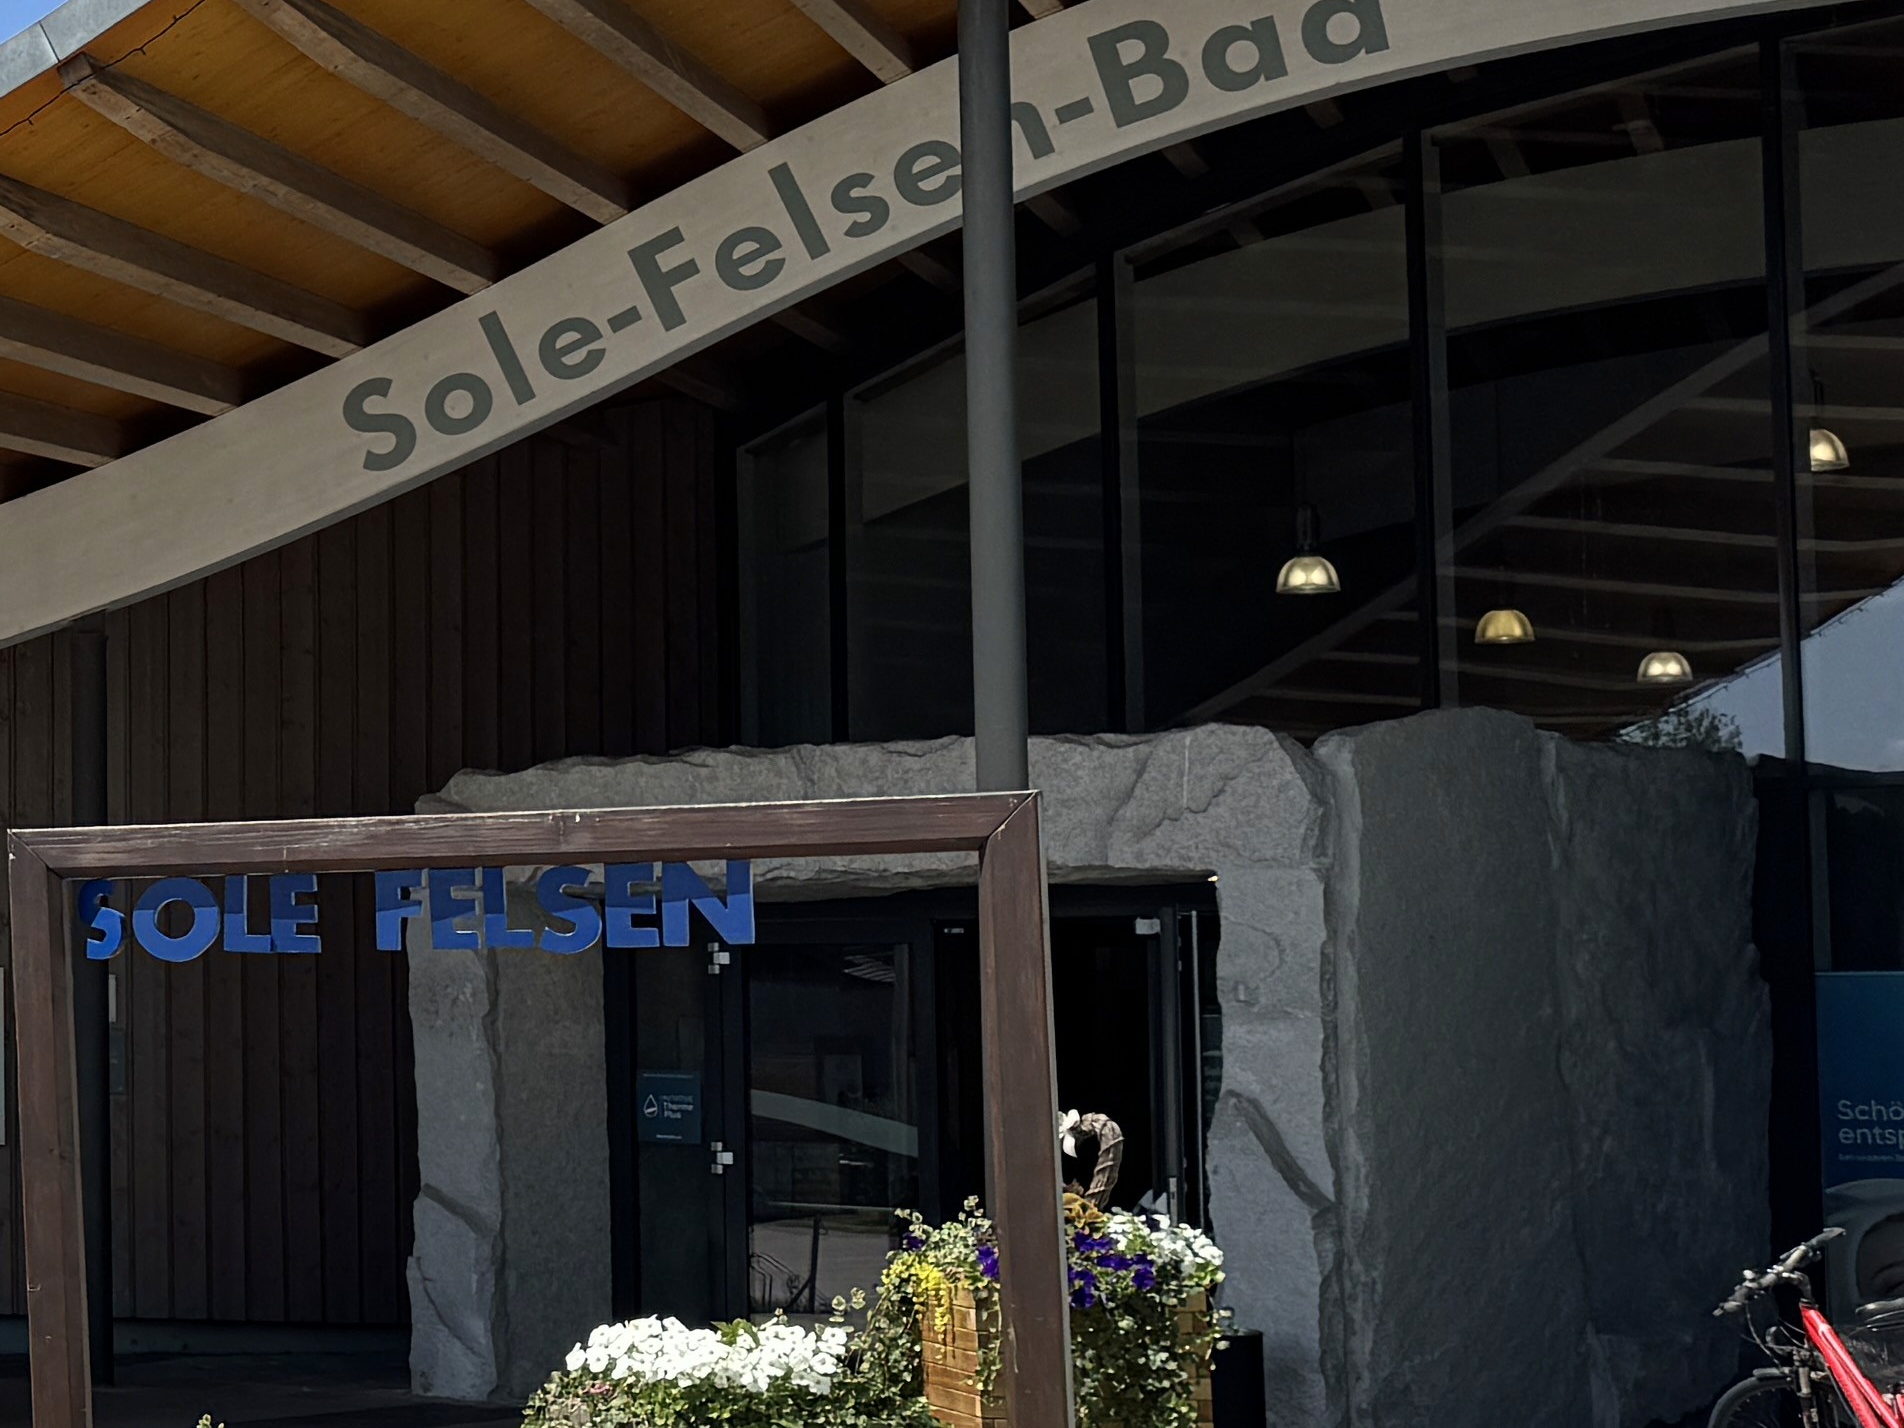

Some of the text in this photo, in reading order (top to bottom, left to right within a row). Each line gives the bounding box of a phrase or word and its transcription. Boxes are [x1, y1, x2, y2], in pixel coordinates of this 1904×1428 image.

[78, 860, 757, 963] SOLE FELSEN
[1837, 1099, 1904, 1121] Schö
